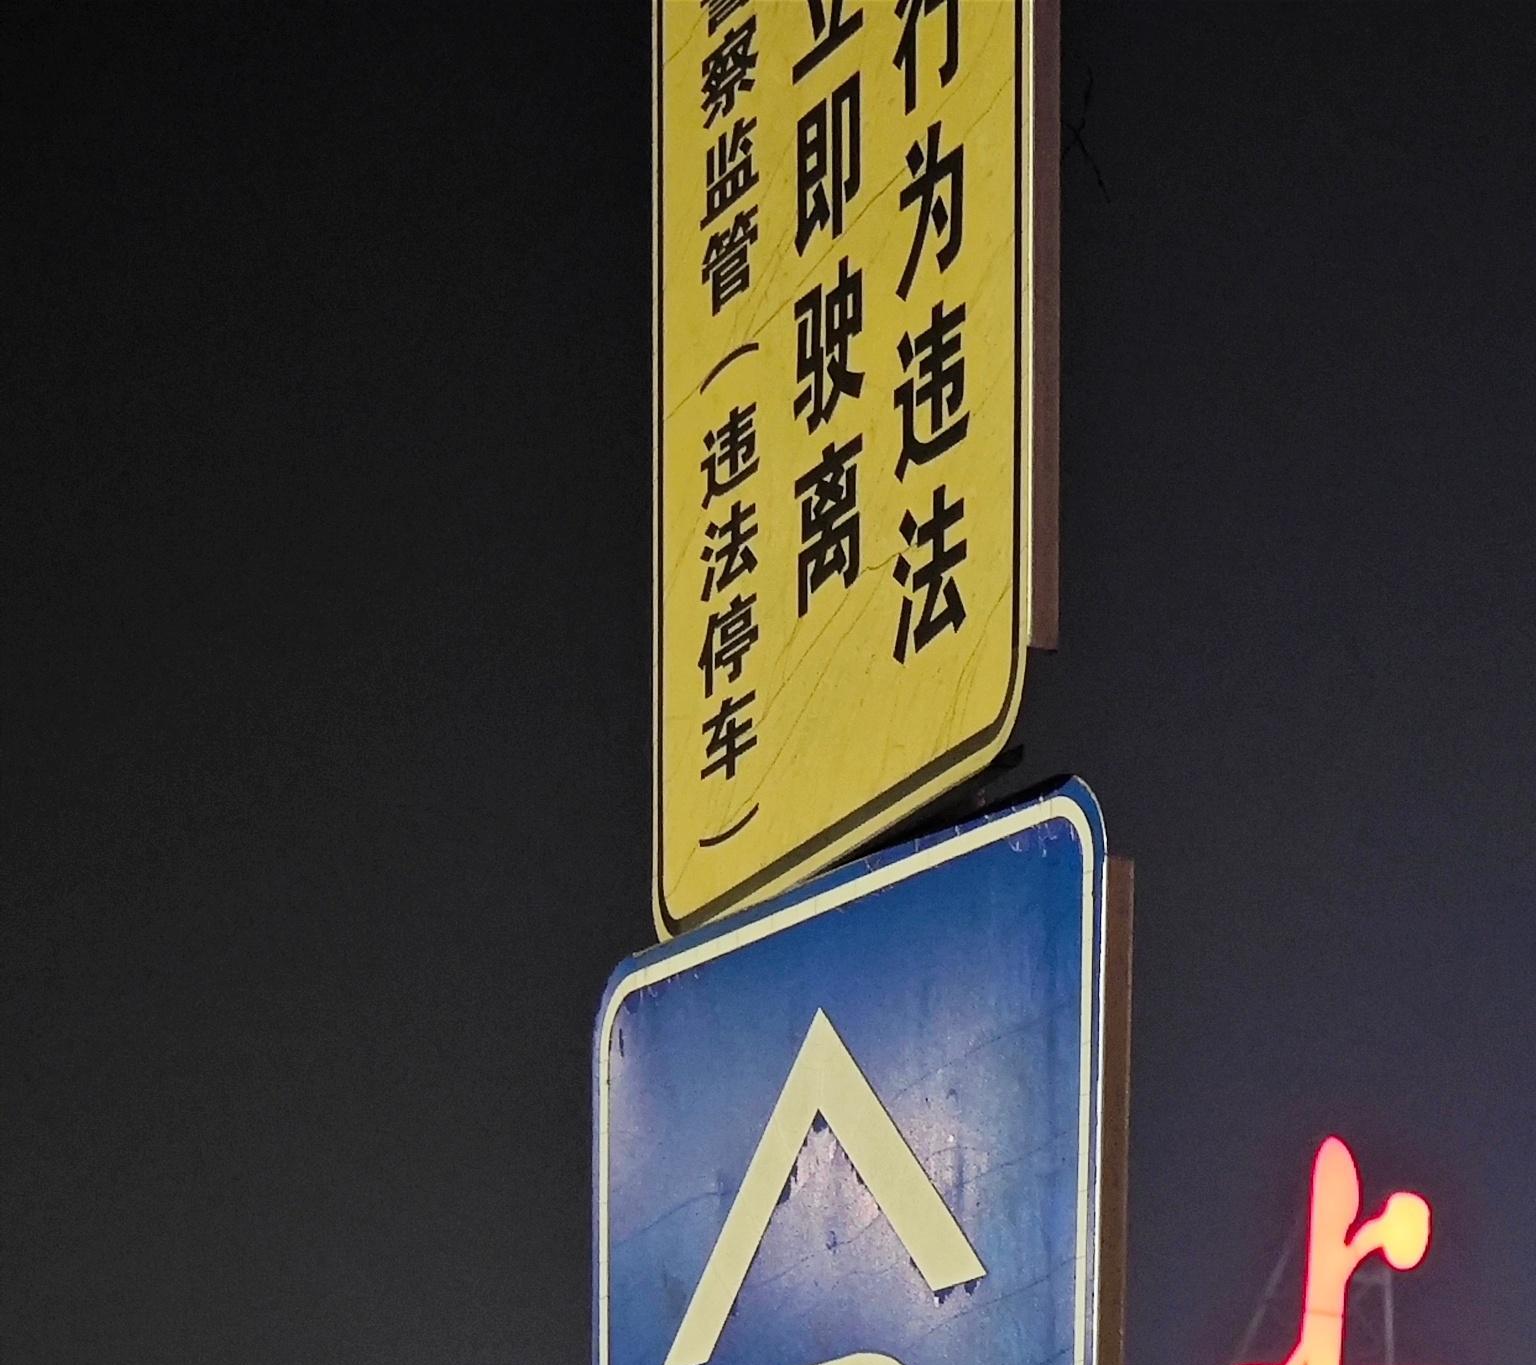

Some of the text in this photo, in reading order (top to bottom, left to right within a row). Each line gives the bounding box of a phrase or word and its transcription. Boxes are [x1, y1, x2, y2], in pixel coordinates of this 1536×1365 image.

[697, 0, 759, 847] 察监管（违法停车）
